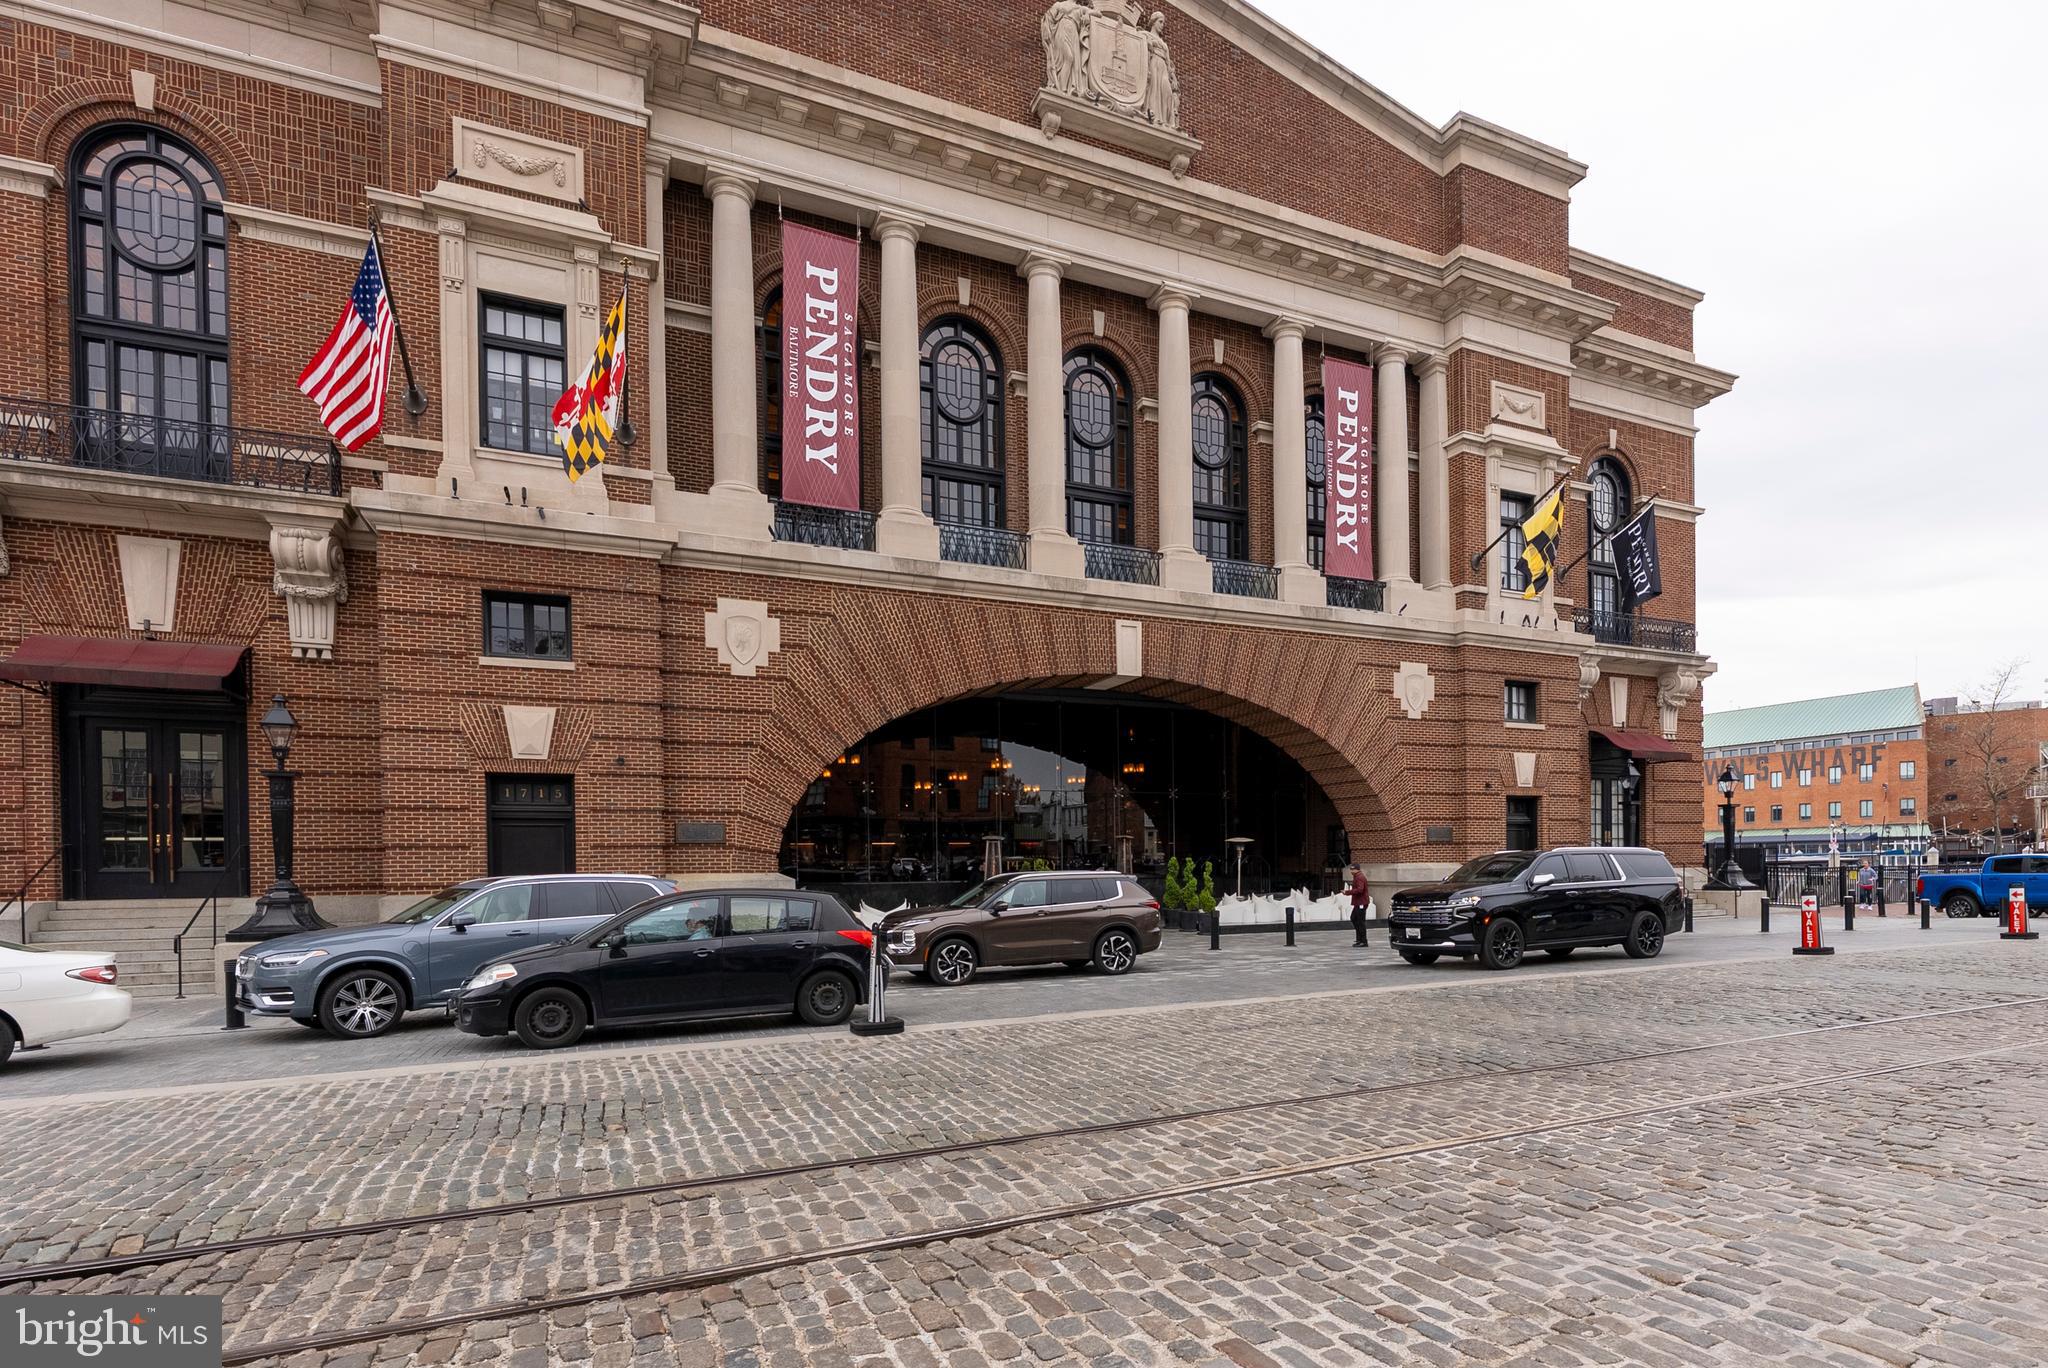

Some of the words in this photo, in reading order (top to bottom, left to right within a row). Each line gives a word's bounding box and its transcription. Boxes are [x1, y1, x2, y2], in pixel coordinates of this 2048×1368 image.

[788, 325, 799, 399] BALTIMORE
[805, 261, 838, 474] PENDRY
[844, 312, 854, 437] SAGAMORE
[1336, 386, 1359, 554] PENDRY
[1361, 425, 1369, 524] SAGAMORE
[504, 787, 562, 799] 1715
[1780, 744, 1887, 780] WHARF
[1805, 911, 1814, 948] VALET
[2013, 902, 2021, 933] VALET
